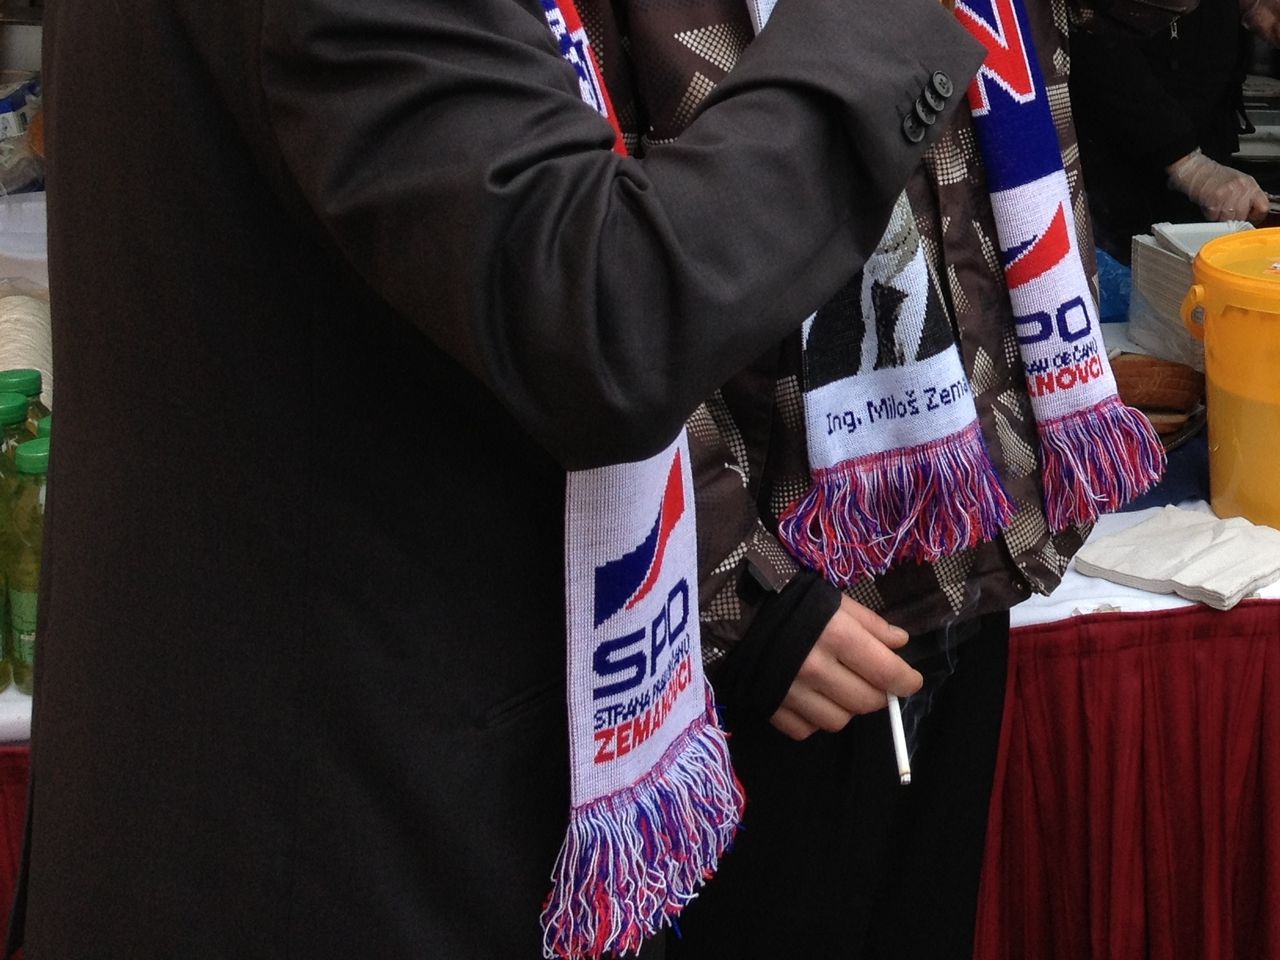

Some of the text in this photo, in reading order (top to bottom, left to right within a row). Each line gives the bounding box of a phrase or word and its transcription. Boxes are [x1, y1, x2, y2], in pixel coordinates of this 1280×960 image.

[826, 411, 862, 435] Ing.
[867, 390, 919, 423] Miloš
[593, 577, 689, 700] SPO
[593, 690, 650, 730] STRANA
